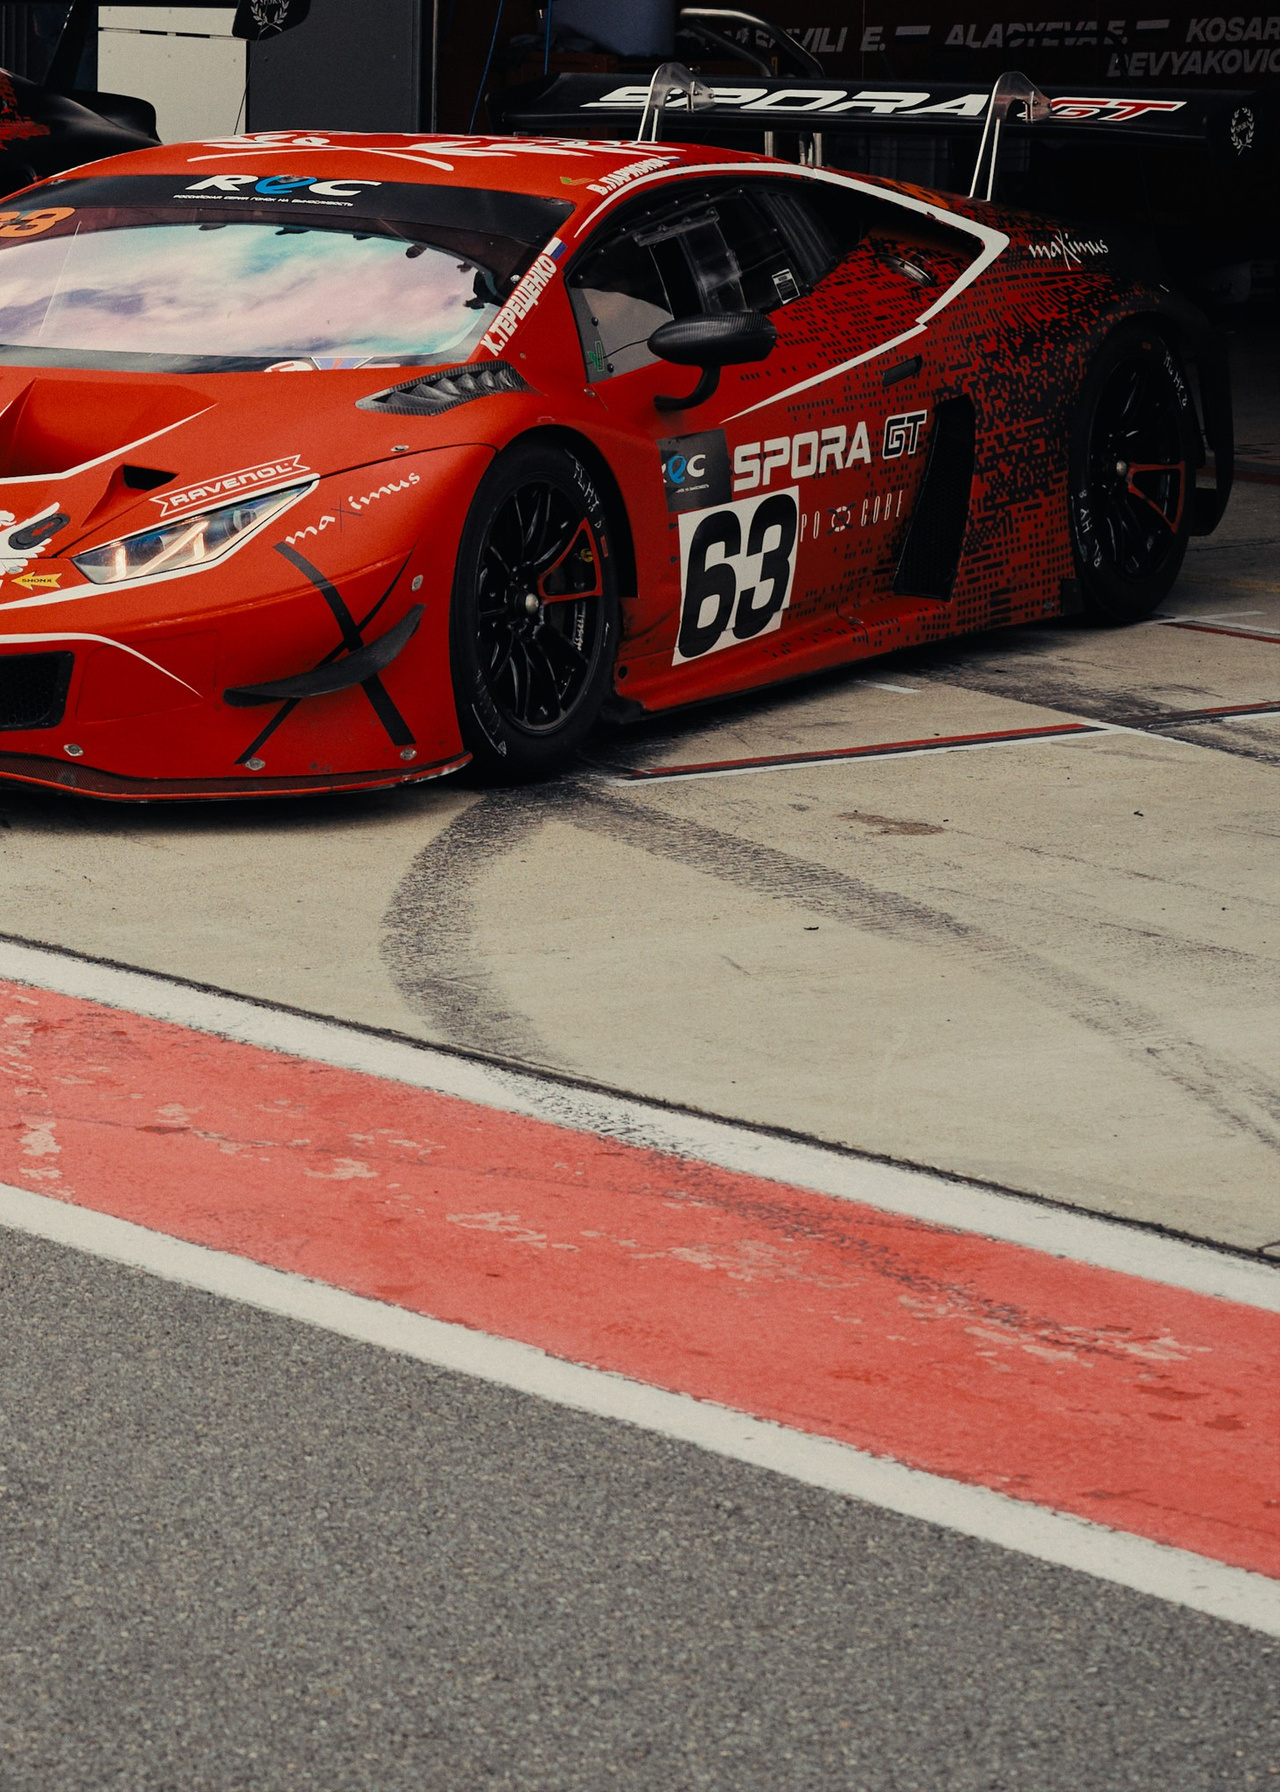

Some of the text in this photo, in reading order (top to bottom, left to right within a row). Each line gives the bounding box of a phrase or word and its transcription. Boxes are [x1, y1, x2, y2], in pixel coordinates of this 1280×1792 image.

[480, 253, 558, 358] К.ТЕРЕЩЕНКО
[169, 462, 292, 507] RAVENOL
[732, 409, 928, 493] SPORA GT
[677, 493, 799, 659] 63
